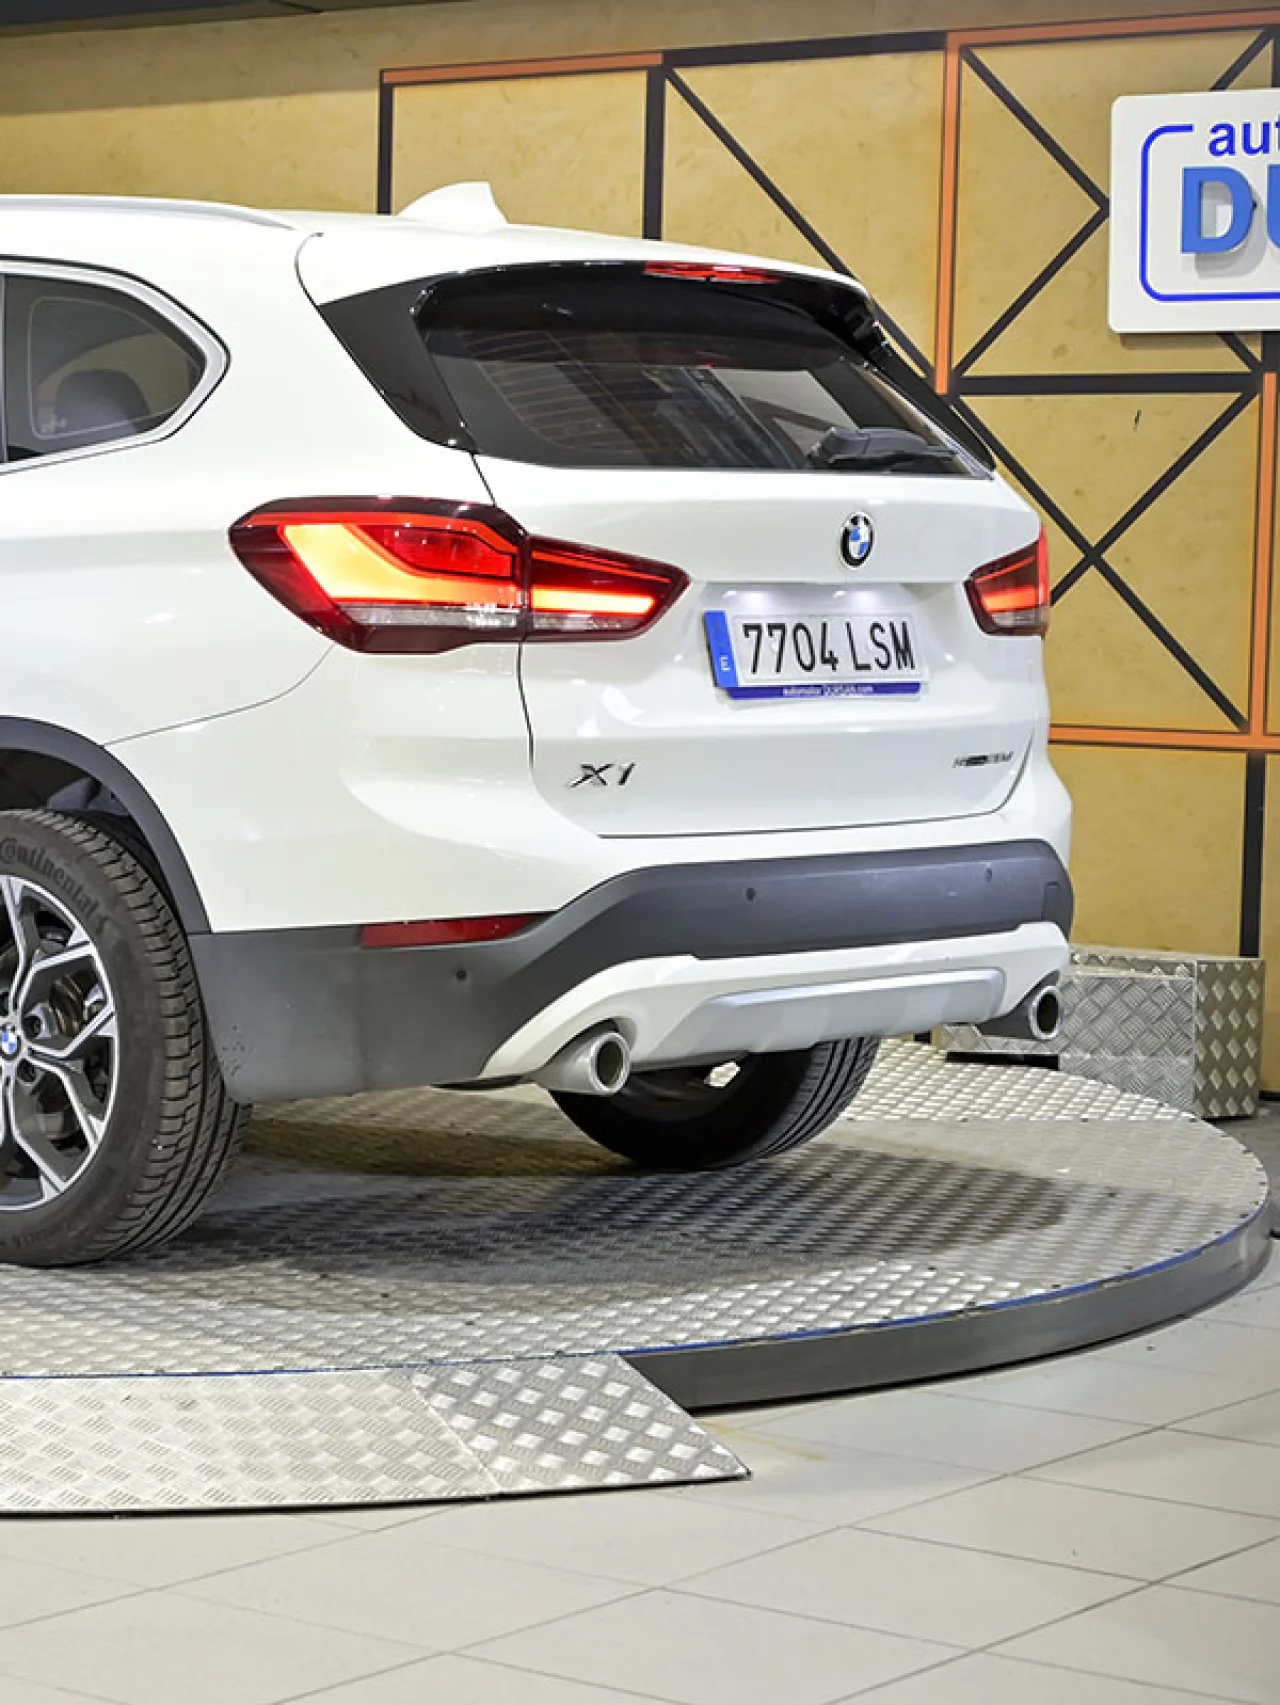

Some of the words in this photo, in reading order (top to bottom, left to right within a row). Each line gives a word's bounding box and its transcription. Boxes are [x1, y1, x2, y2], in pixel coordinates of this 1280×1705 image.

[1181, 163, 1280, 254] D
[743, 621, 838, 674] 7704
[845, 620, 915, 670] LSM
[567, 762, 636, 788] X1
